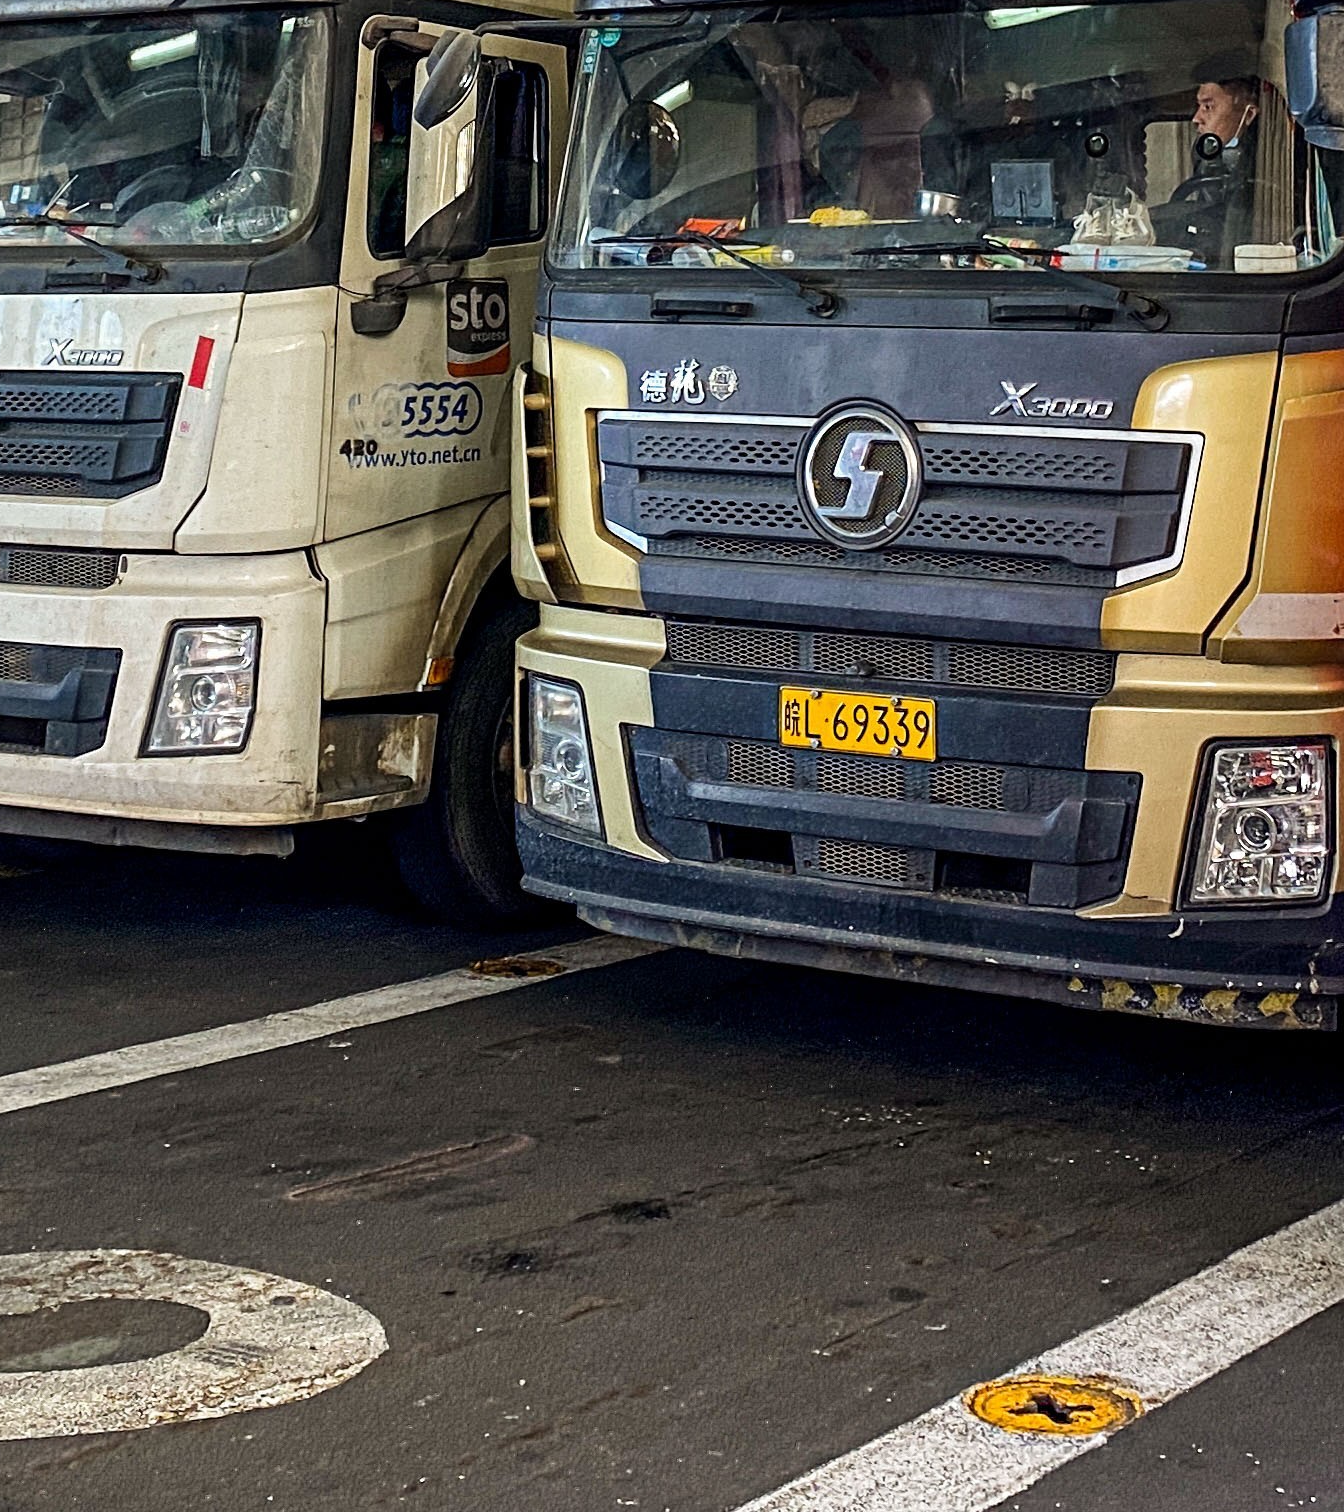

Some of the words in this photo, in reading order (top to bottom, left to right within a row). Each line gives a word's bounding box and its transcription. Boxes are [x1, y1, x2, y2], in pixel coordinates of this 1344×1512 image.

[450, 287, 506, 330] sto
[43, 338, 124, 366] X3000
[471, 331, 506, 342] express
[989, 381, 1114, 419] X3000
